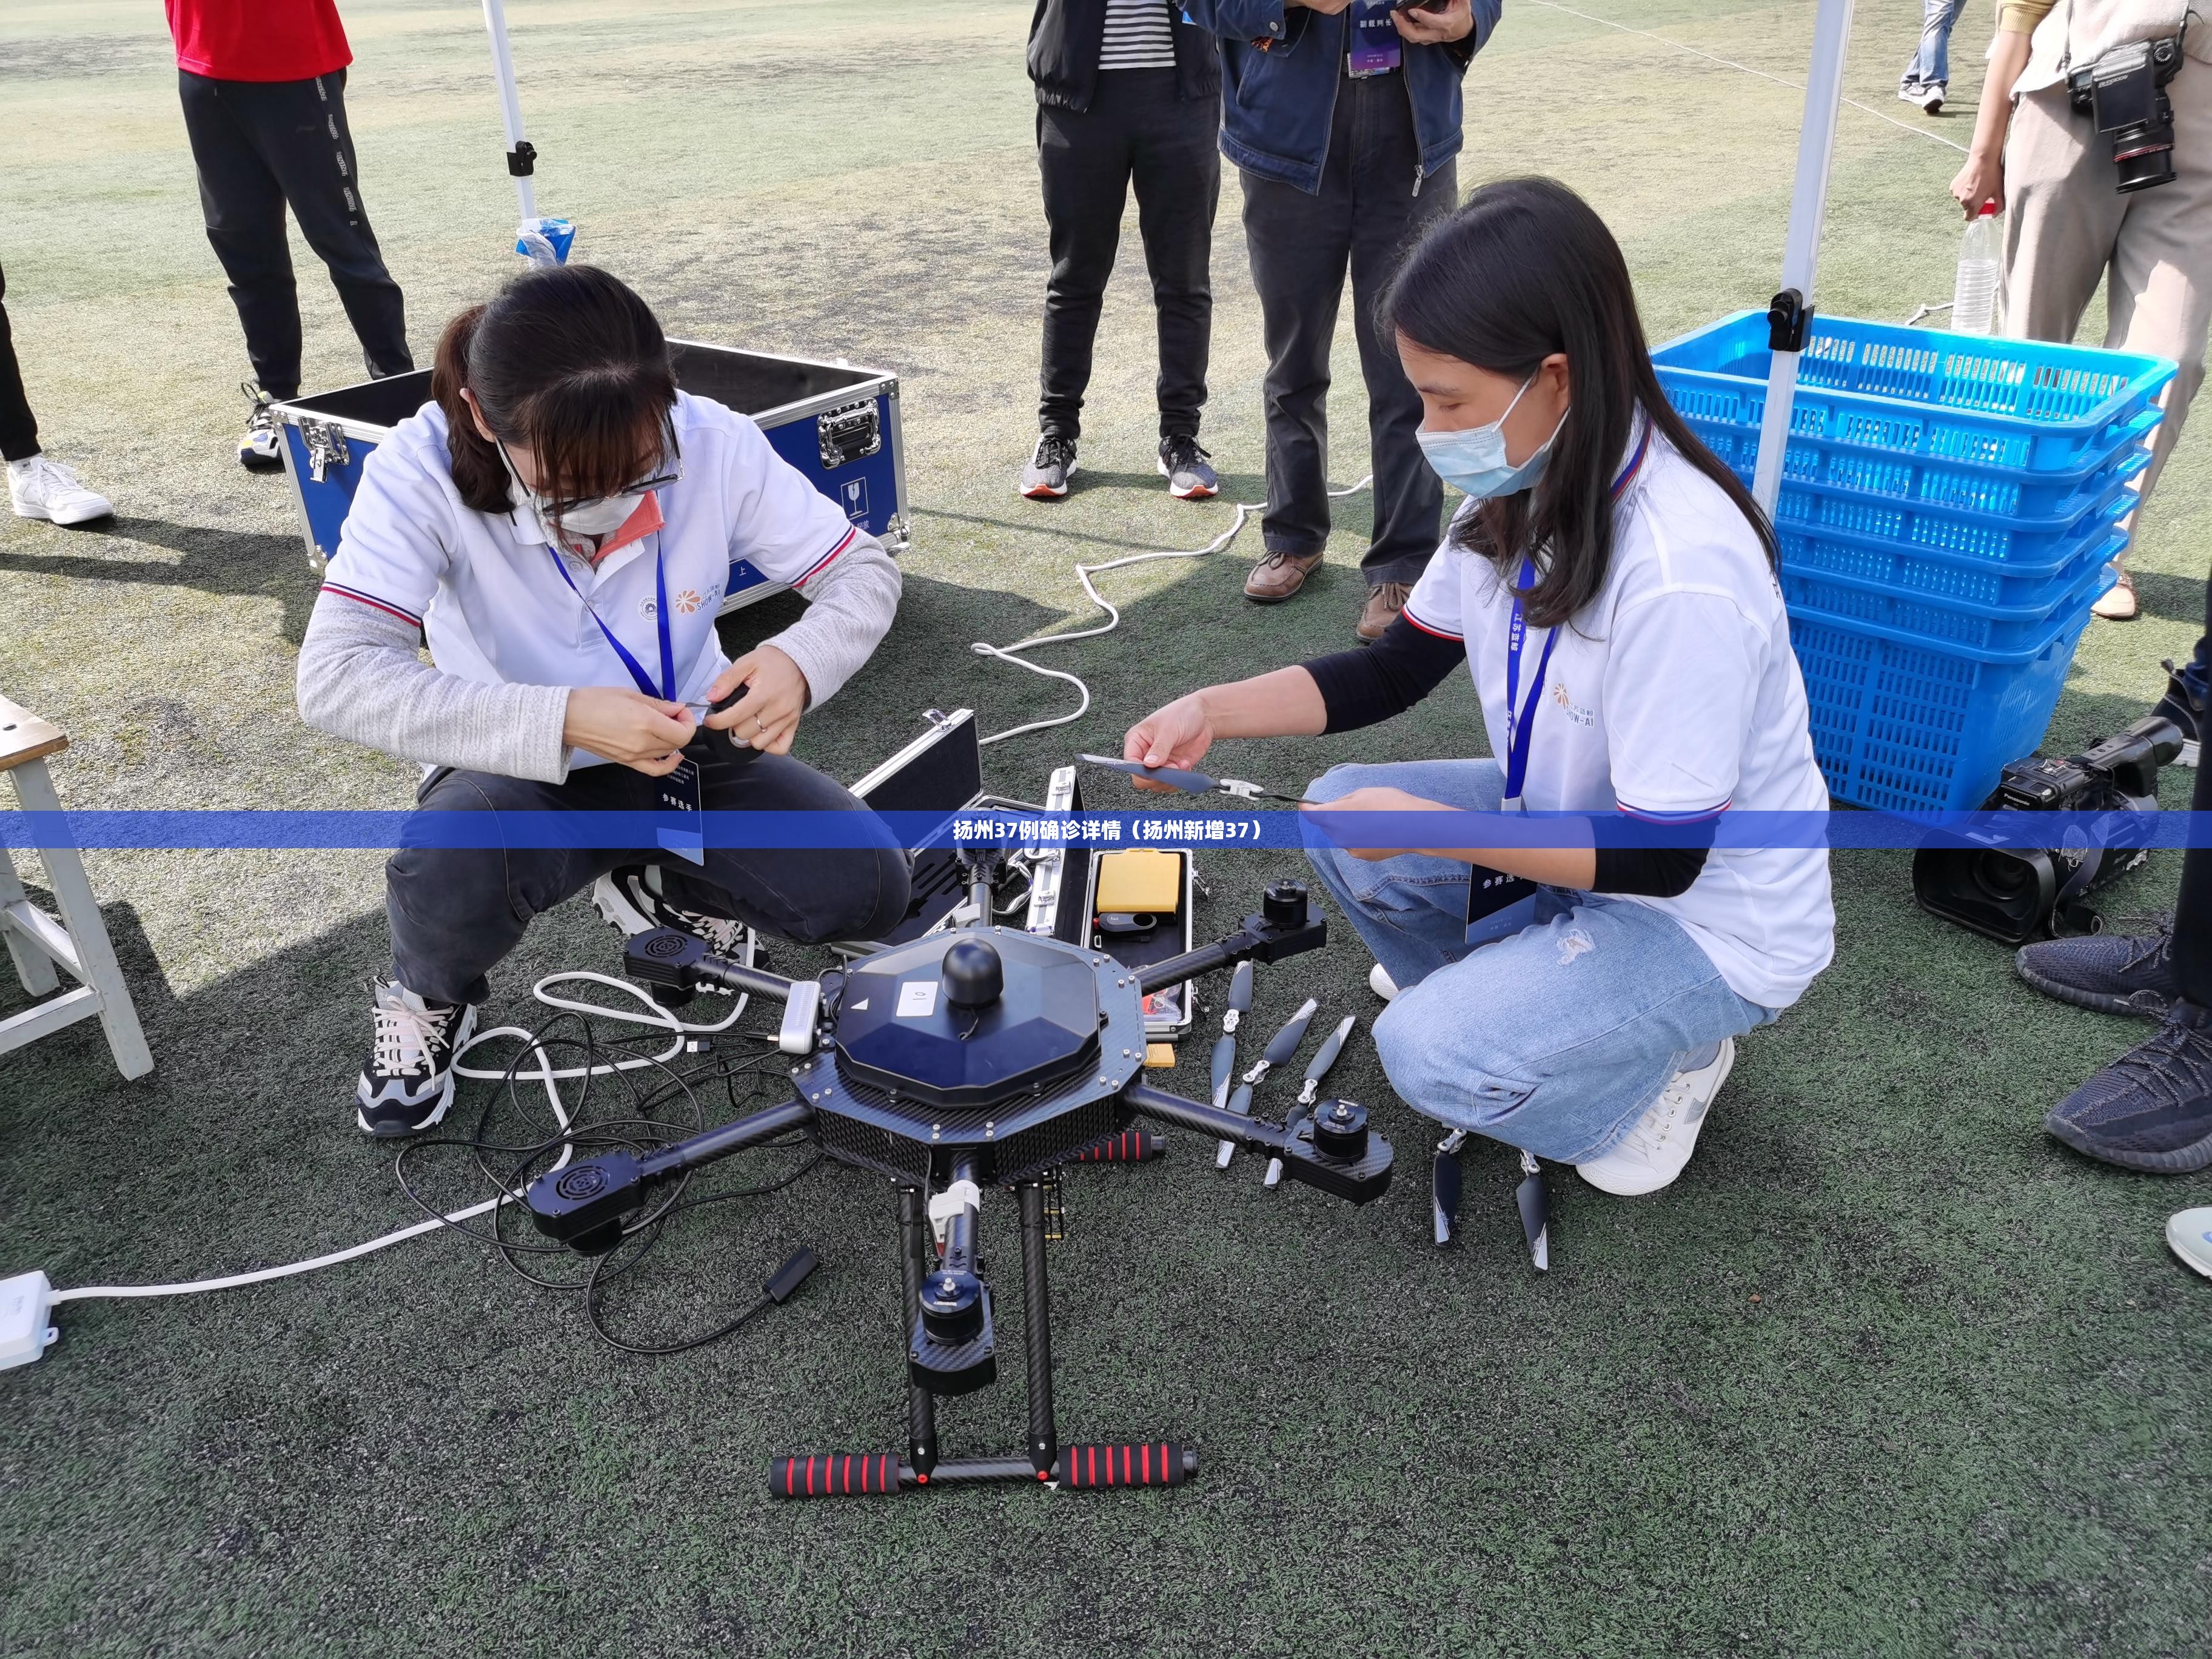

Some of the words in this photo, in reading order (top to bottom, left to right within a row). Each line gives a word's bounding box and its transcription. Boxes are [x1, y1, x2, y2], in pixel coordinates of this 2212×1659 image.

[739, 566, 746, 576] 上
[1566, 705, 1594, 727] SHOW-AI
[662, 793, 692, 813] 参赛选手
[2004, 793, 2030, 806] Panasonic
[1483, 873, 1523, 889] 参赛选
